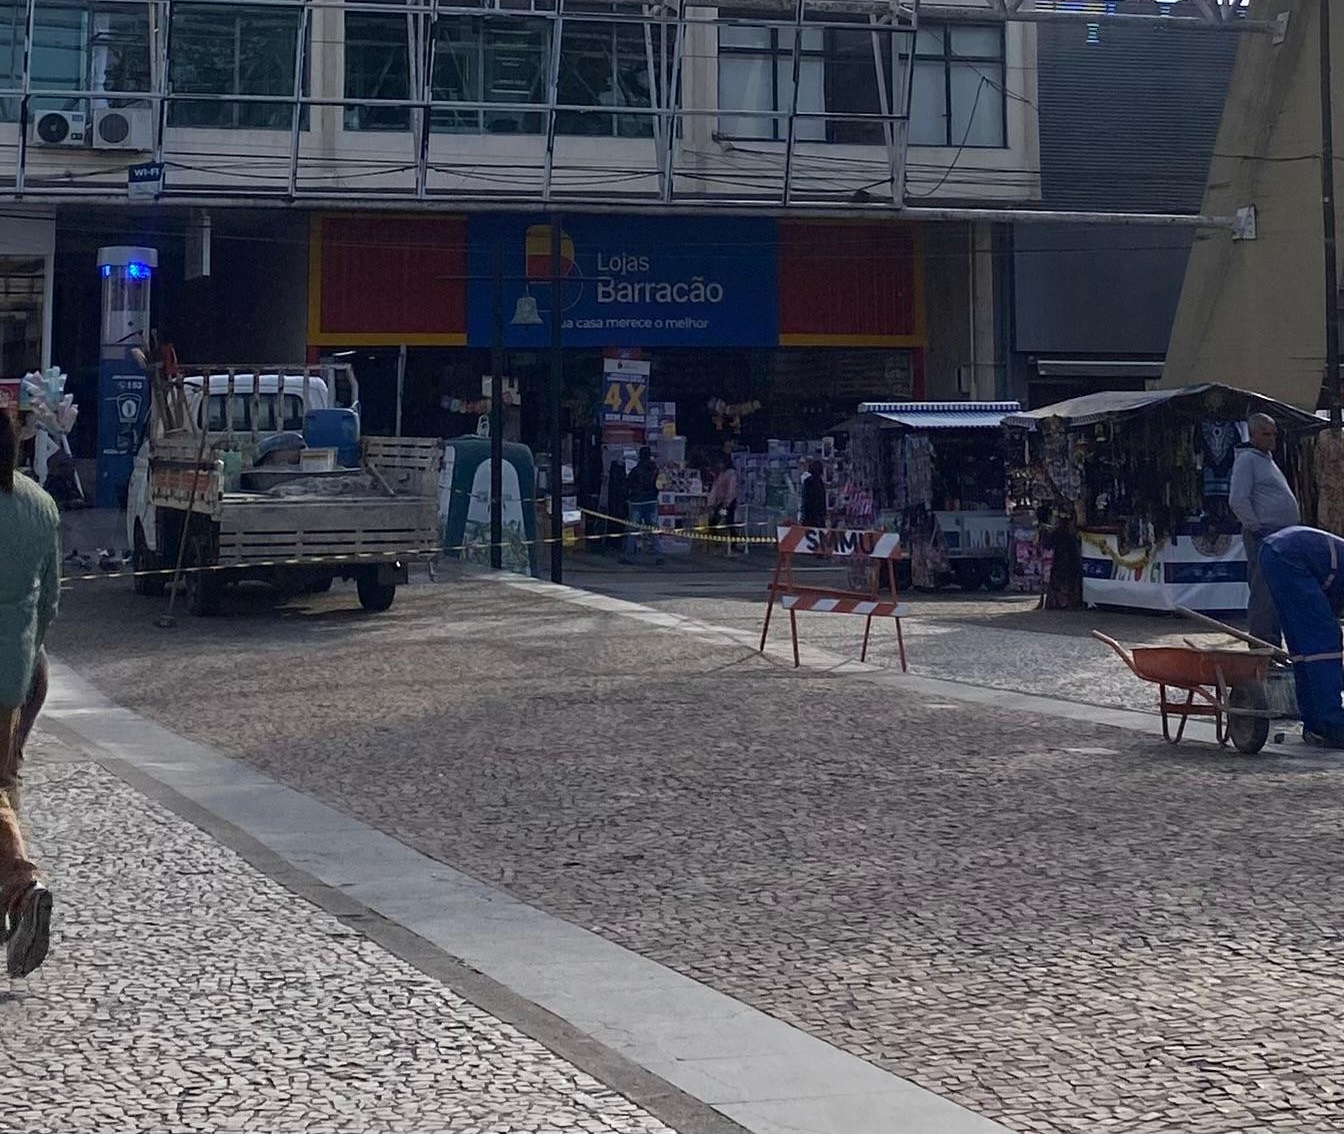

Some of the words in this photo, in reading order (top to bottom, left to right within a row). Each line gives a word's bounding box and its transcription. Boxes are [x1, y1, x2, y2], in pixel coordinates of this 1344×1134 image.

[597, 252, 650, 276] Lojas
[596, 276, 724, 304] Barracão
[575, 318, 604, 329] casa
[606, 318, 653, 329] merece
[654, 319, 663, 329] o
[665, 316, 710, 329] melhor
[806, 529, 877, 554] SMMU
